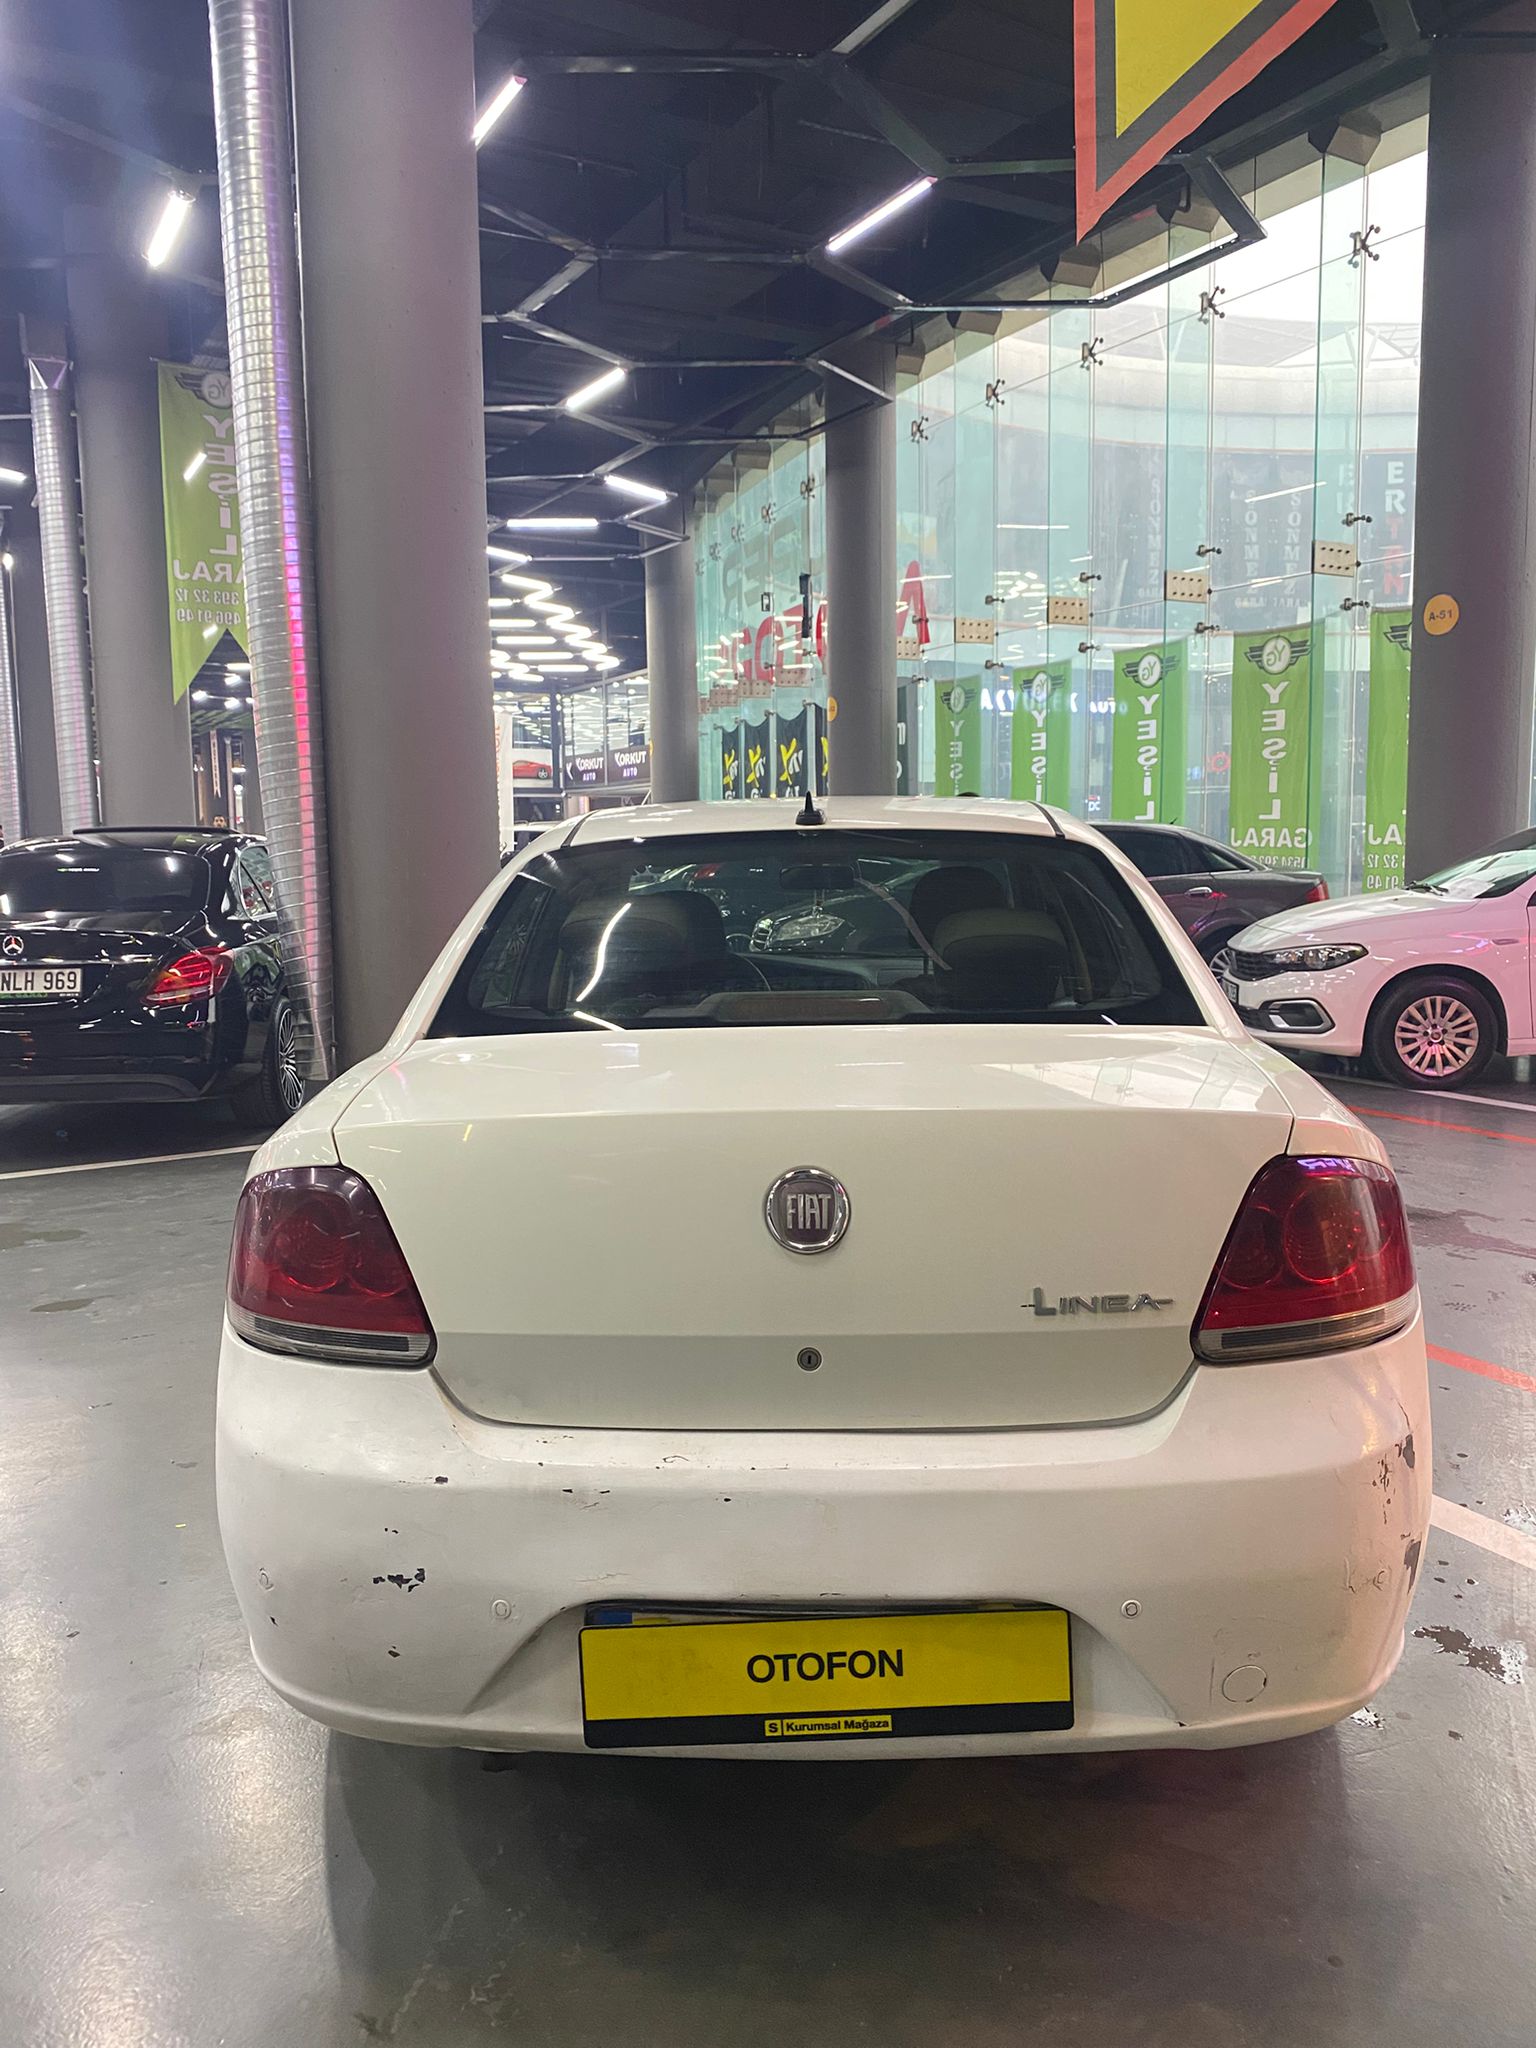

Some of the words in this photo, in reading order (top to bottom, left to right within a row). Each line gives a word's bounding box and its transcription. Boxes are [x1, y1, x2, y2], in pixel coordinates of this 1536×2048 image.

[1428, 609, 1453, 622] A-51
[575, 757, 604, 771] KORKUT
[614, 751, 647, 767] KORKUT
[623, 767, 638, 777] AUTO
[1, 971, 35, 991] NLH
[43, 971, 77, 990] 969
[786, 1193, 831, 1231] FIAT
[1021, 1287, 1173, 1317] LINEA
[745, 1649, 905, 1684] OTOFON
[786, 1721, 841, 1732] Kurumsal
[844, 1718, 889, 1731] Mağaza
